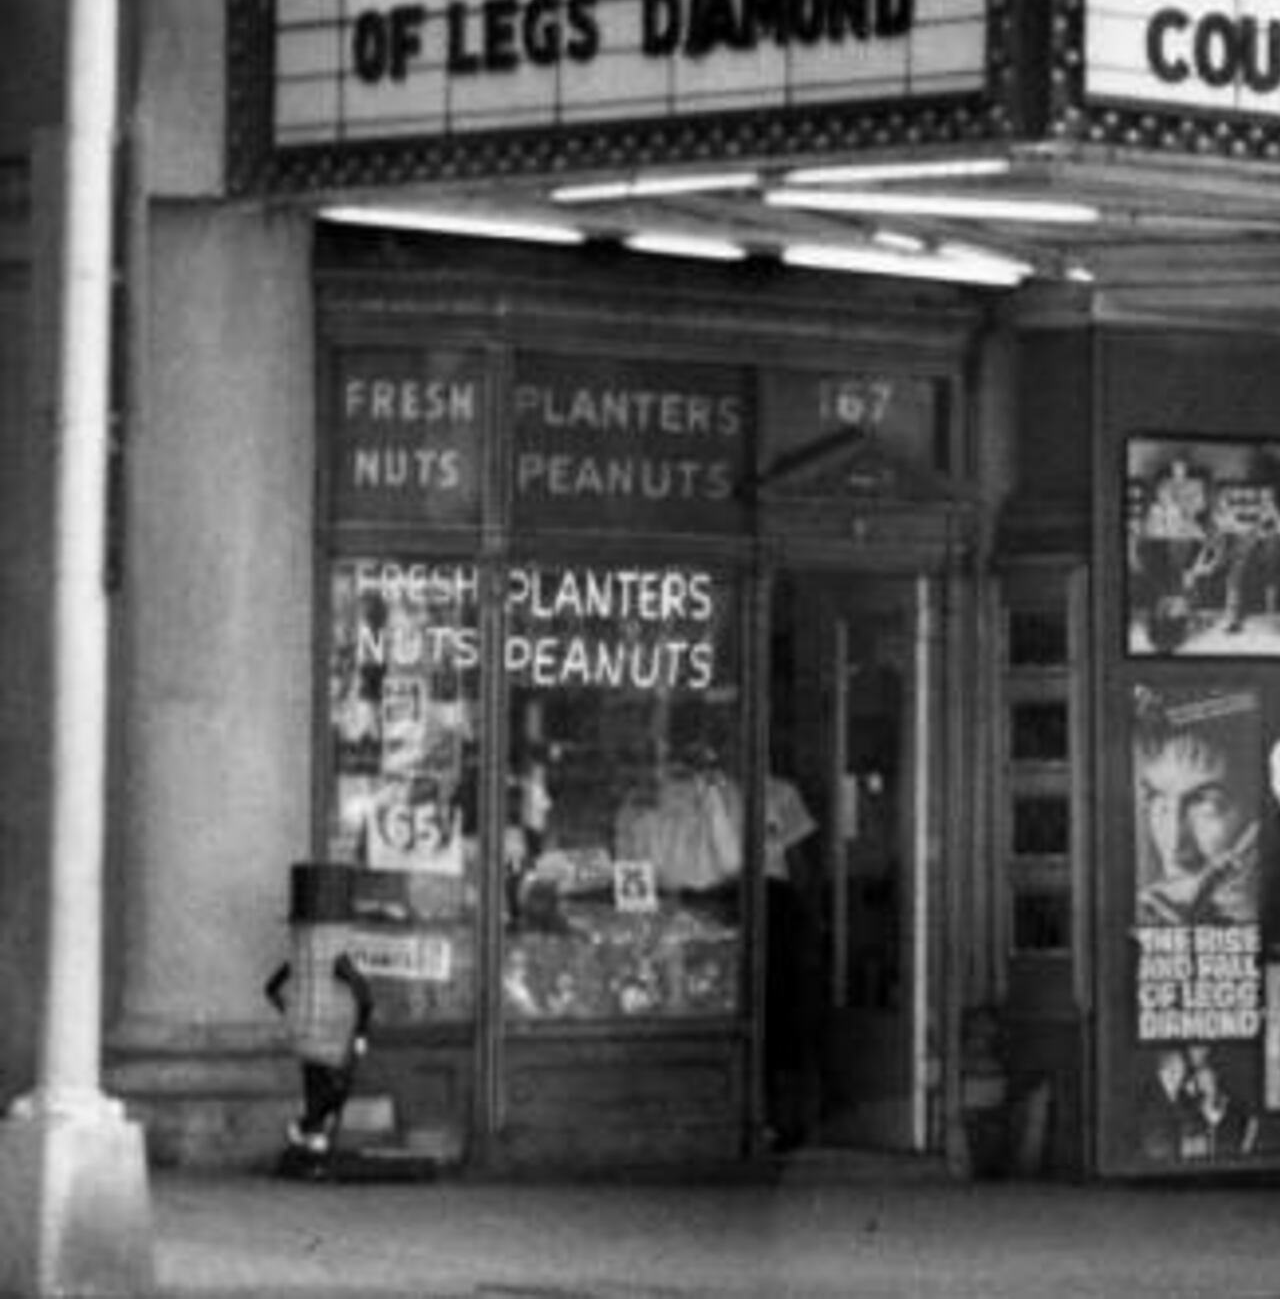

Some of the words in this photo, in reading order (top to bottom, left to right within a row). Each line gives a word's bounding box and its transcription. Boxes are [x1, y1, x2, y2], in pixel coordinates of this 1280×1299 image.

[352, 5, 425, 84] OF
[344, 380, 476, 422] FRESH
[513, 384, 740, 435] PLANTERS
[352, 448, 461, 490] NUTS
[517, 453, 733, 500] PEANUTS
[354, 559, 479, 605] FRESH
[504, 566, 712, 621] PLANTERS
[355, 619, 479, 668] NUTS
[504, 635, 713, 689] PEANUTS
